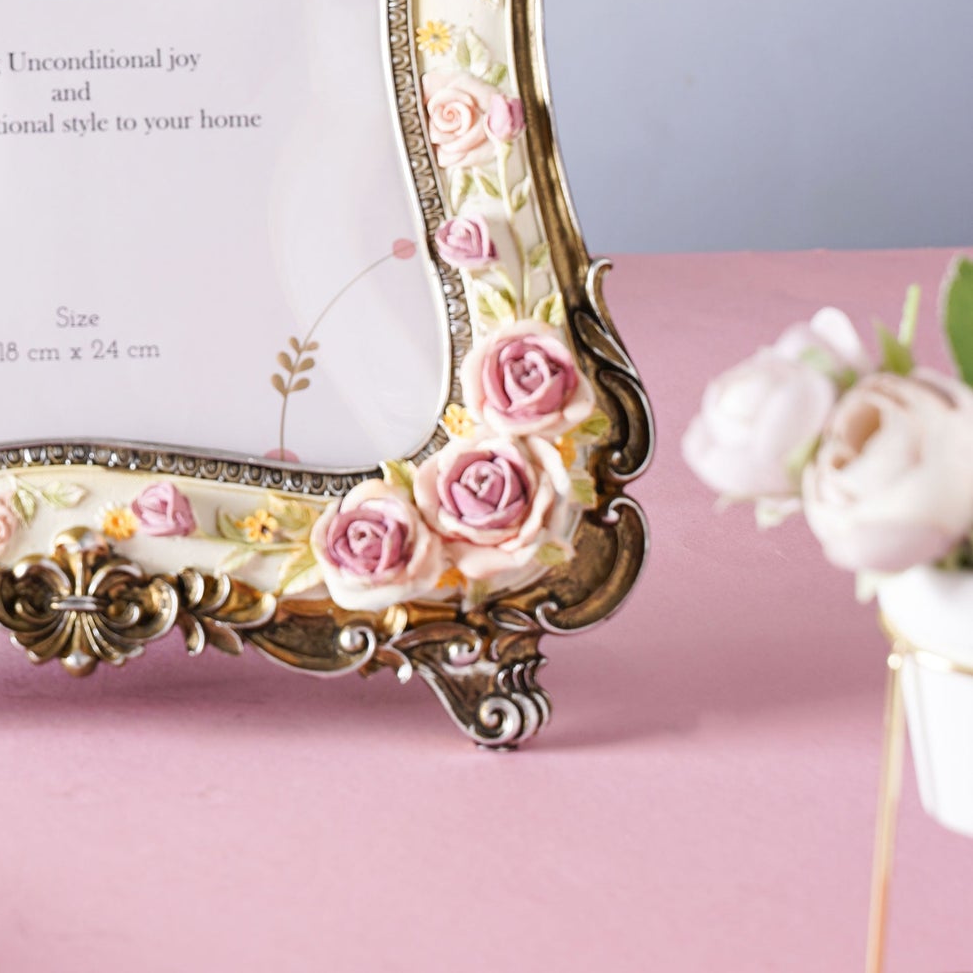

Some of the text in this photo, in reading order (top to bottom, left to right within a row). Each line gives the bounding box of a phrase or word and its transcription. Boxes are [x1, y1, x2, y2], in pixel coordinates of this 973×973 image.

[8, 48, 162, 73] Unconditional
[167, 47, 201, 72] joy
[51, 81, 91, 102] and
[62, 111, 109, 137] style
[116, 116, 137, 131] to
[144, 115, 192, 135] your
[200, 108, 262, 129] home
[56, 305, 100, 328] Size
[27, 348, 60, 362] cm
[70, 346, 82, 360] x
[90, 339, 119, 359] 24
[127, 344, 160, 359] cm
